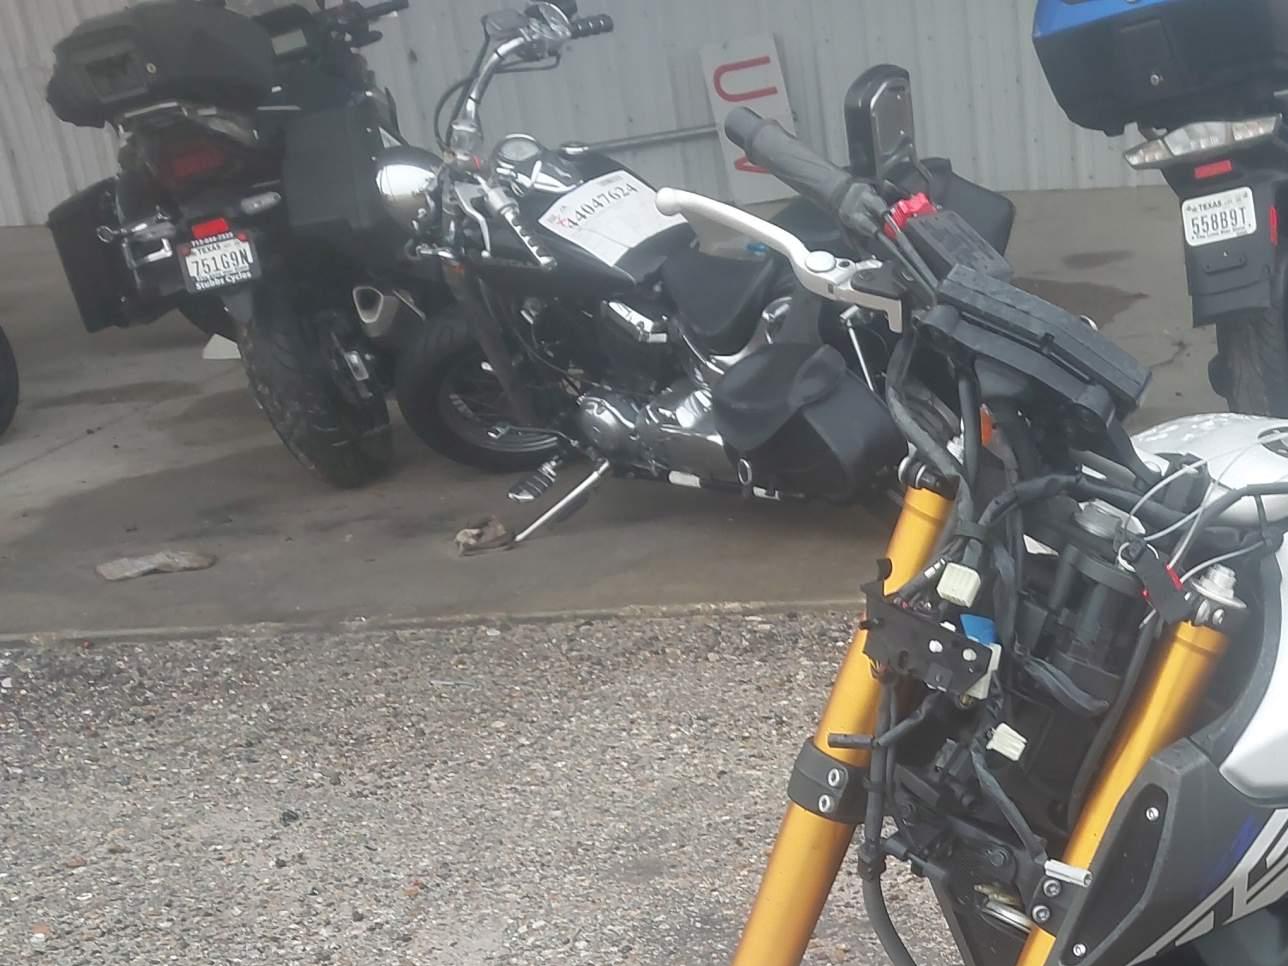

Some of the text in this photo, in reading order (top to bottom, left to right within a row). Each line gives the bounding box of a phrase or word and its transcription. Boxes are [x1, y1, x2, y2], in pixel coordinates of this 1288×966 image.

[1198, 200, 1222, 211] TEXAS
[1191, 207, 1246, 235] 558B9T
[197, 243, 221, 255] TEXAS
[191, 248, 249, 277] 751G9N
